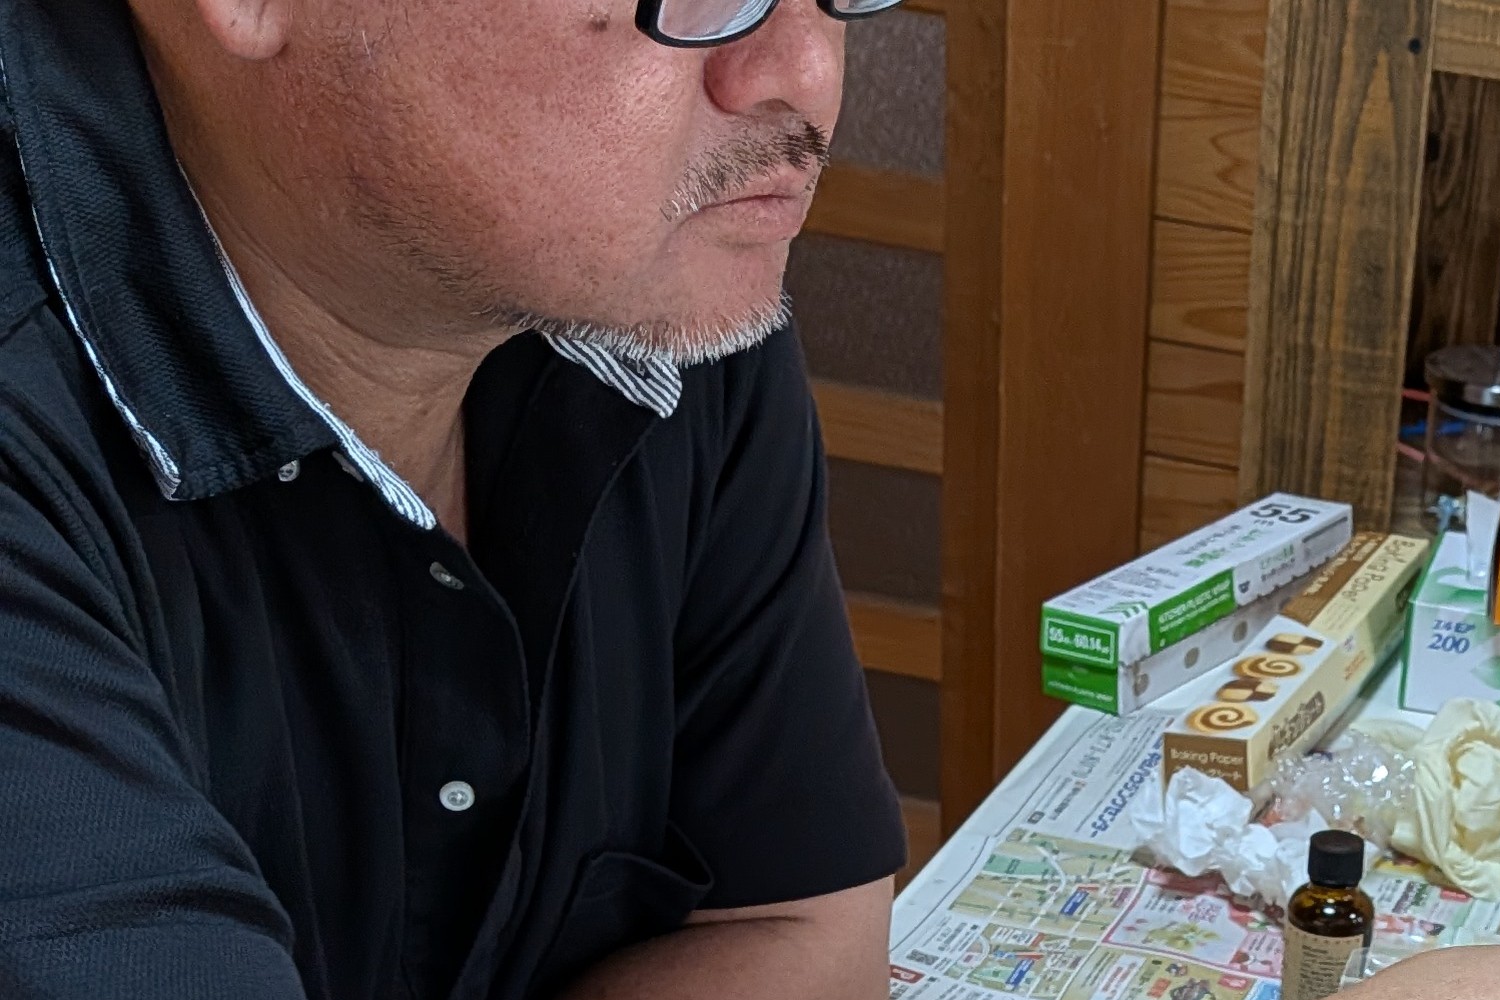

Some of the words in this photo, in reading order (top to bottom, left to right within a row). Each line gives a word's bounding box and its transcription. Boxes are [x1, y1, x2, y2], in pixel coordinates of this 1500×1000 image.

[1250, 502, 1320, 524] 55
[1427, 633, 1470, 654] 200
[1170, 748, 1208, 764] Baking
